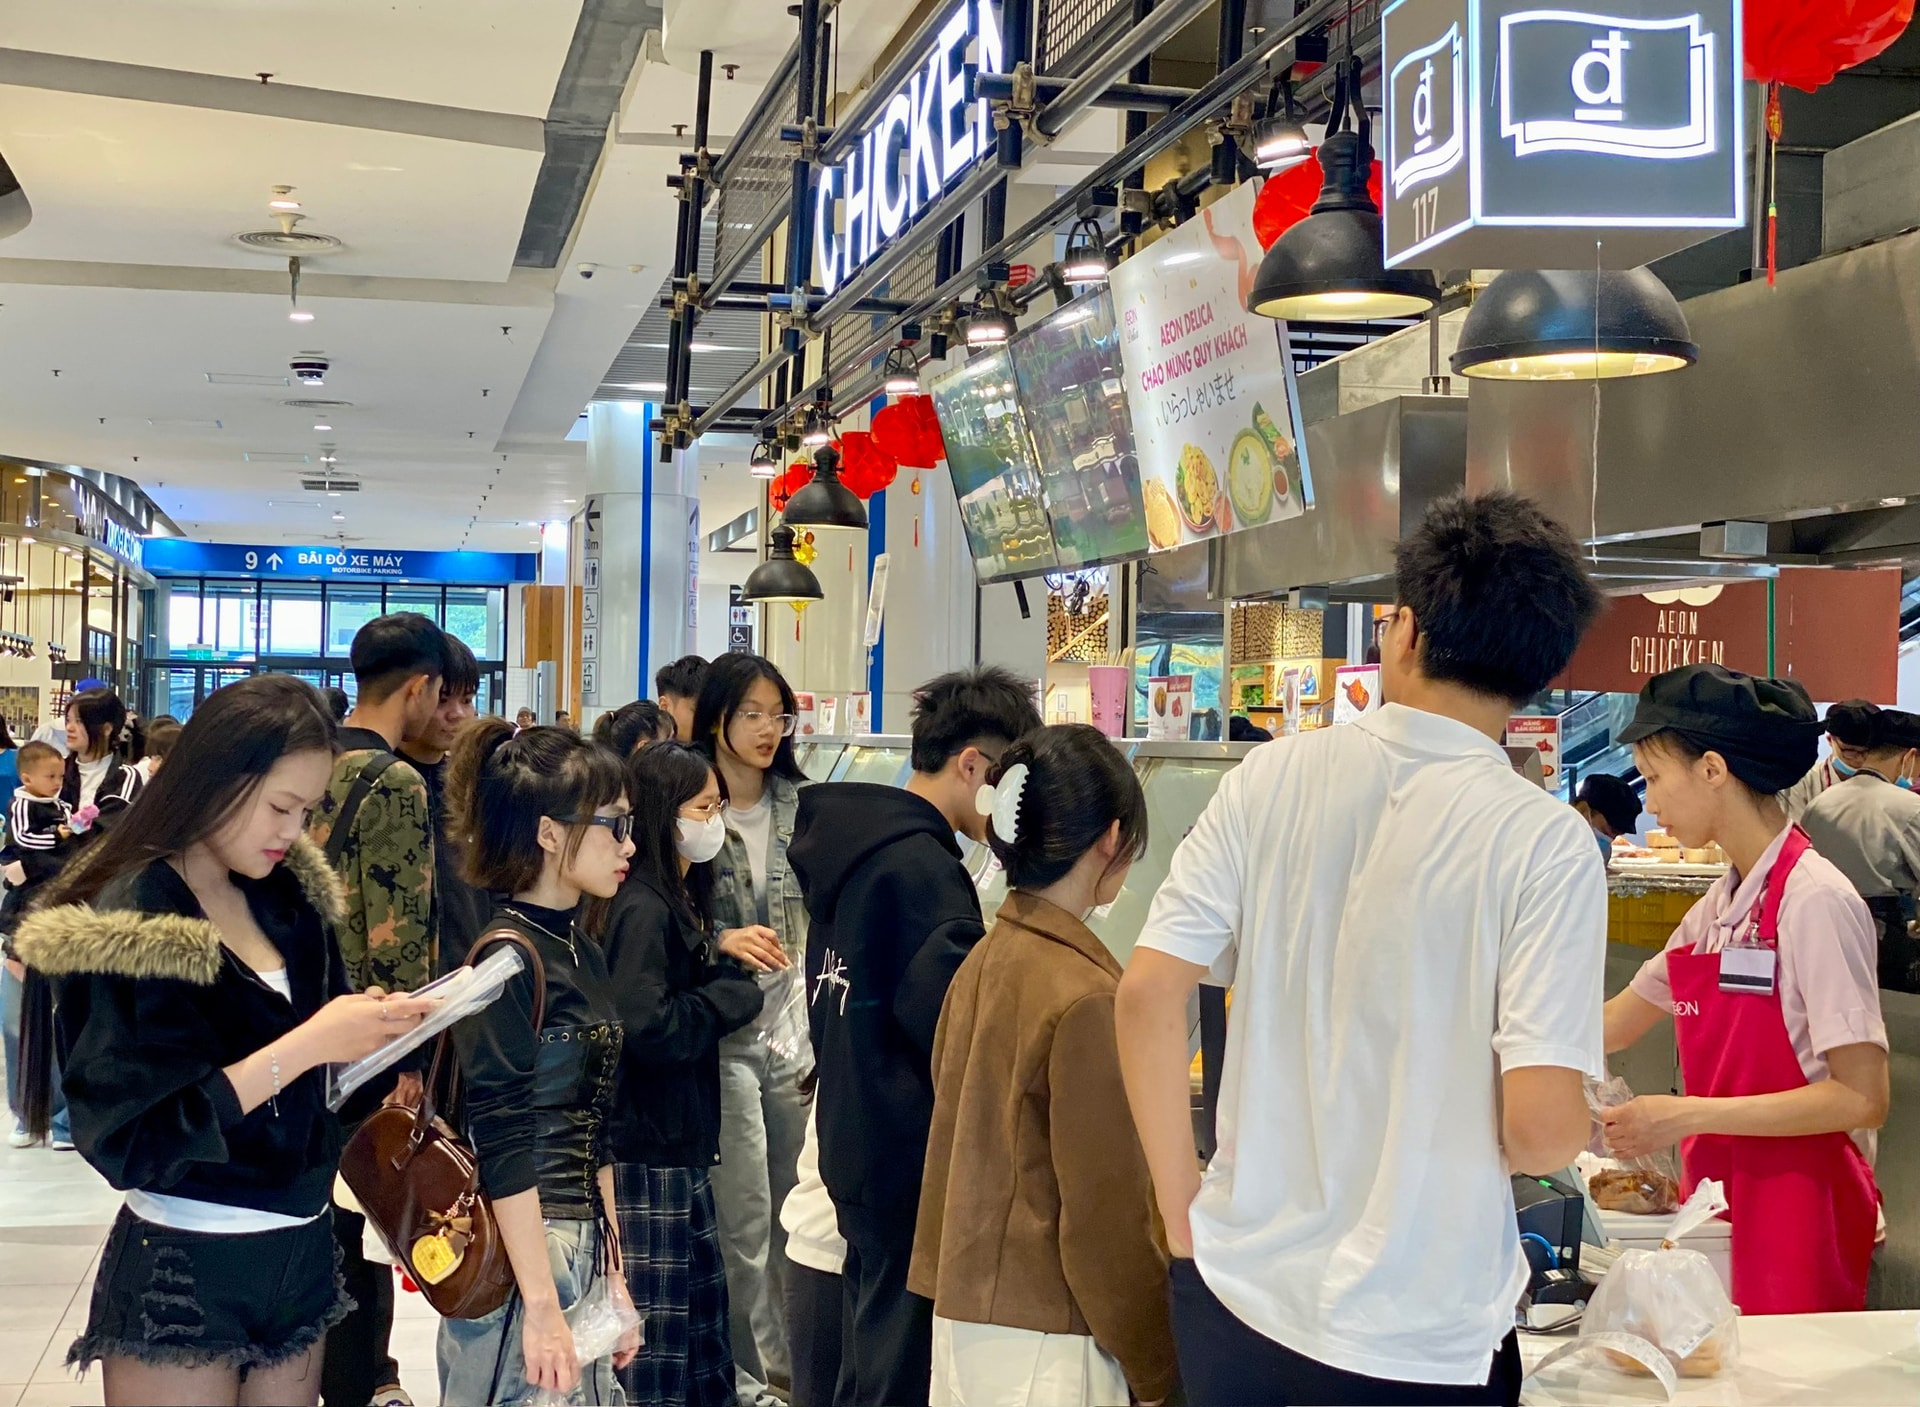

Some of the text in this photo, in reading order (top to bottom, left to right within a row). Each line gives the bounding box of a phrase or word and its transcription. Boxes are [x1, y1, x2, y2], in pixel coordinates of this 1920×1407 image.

[1412, 186, 1438, 243] 117
[1160, 301, 1214, 347] AEON DELICA
[1161, 368, 1236, 425] いらっしゃいませ
[245, 551, 258, 570] 9
[298, 551, 322, 564] BÃI
[351, 555, 369, 566] XE
[373, 553, 403, 567] MÁY
[1657, 610, 1697, 635] AEON
[1630, 636, 1724, 674] CHICKEN
